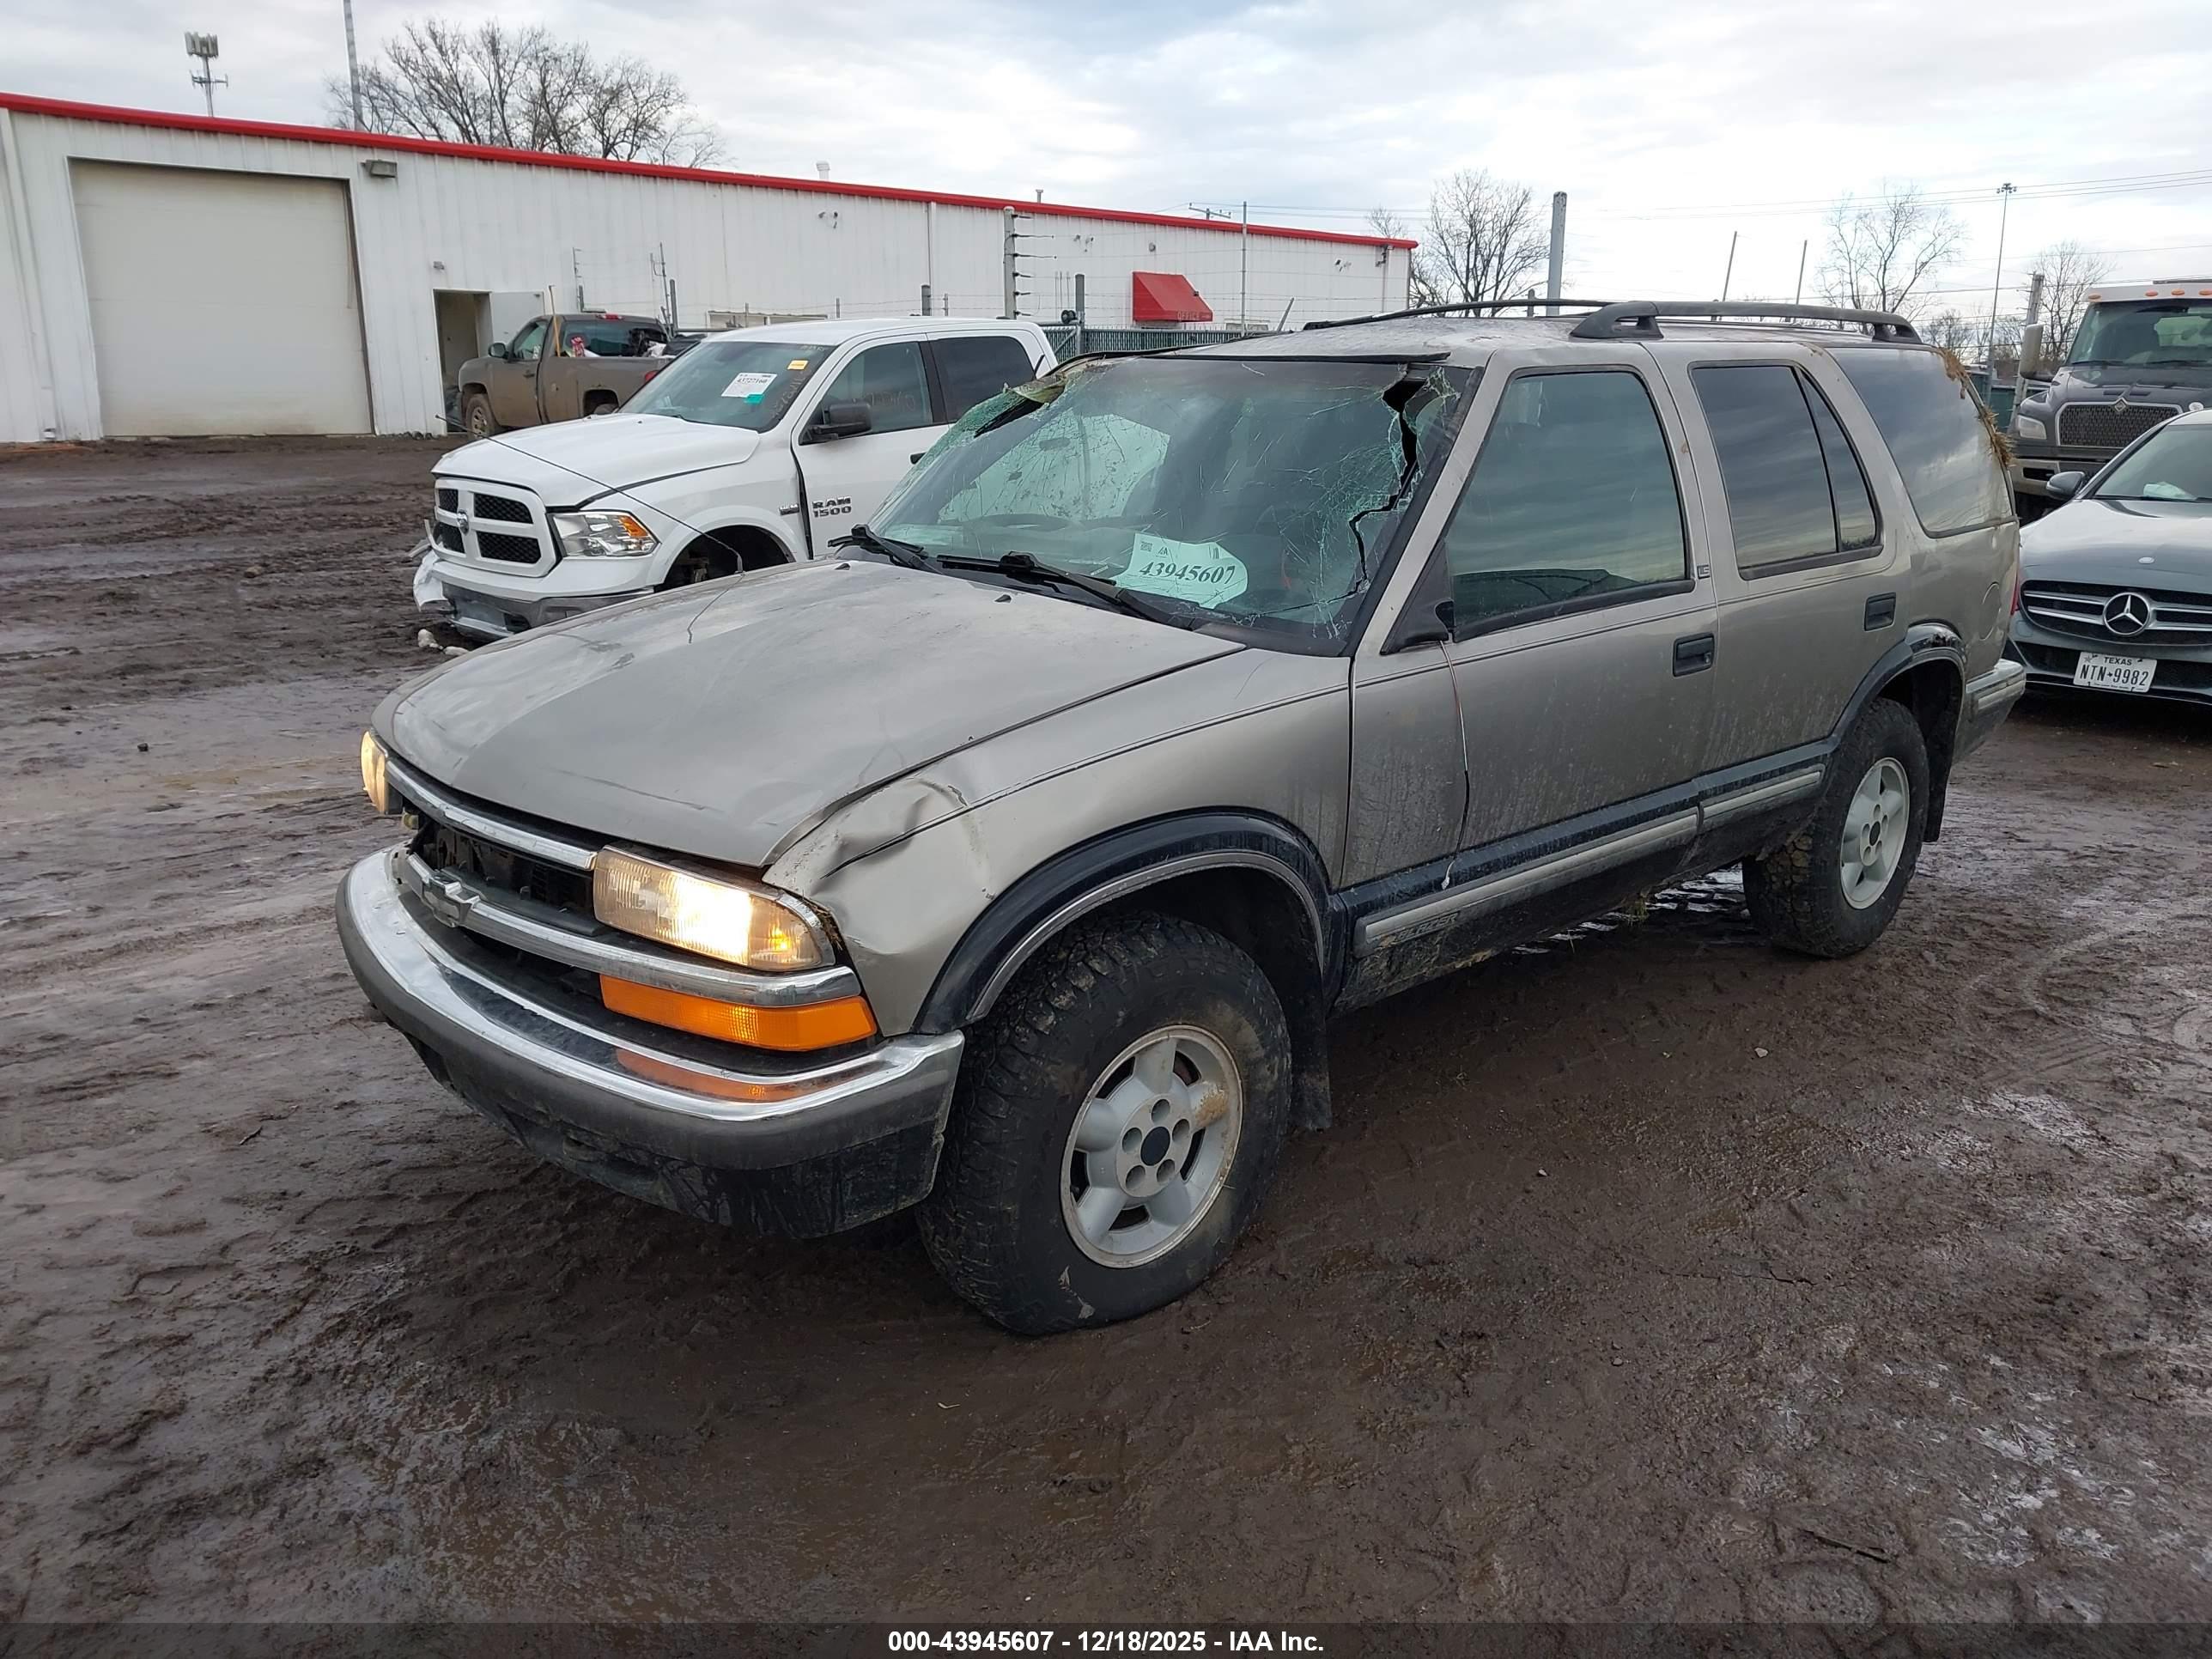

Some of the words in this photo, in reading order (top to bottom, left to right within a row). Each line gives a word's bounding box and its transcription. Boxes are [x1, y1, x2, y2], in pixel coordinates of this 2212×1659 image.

[812, 496, 851, 509] RAM
[813, 506, 852, 518] 1500
[1139, 562, 1236, 585] 43945607
[2104, 656, 2132, 665] TEXAS
[1398, 914, 1458, 939] BLAZER
